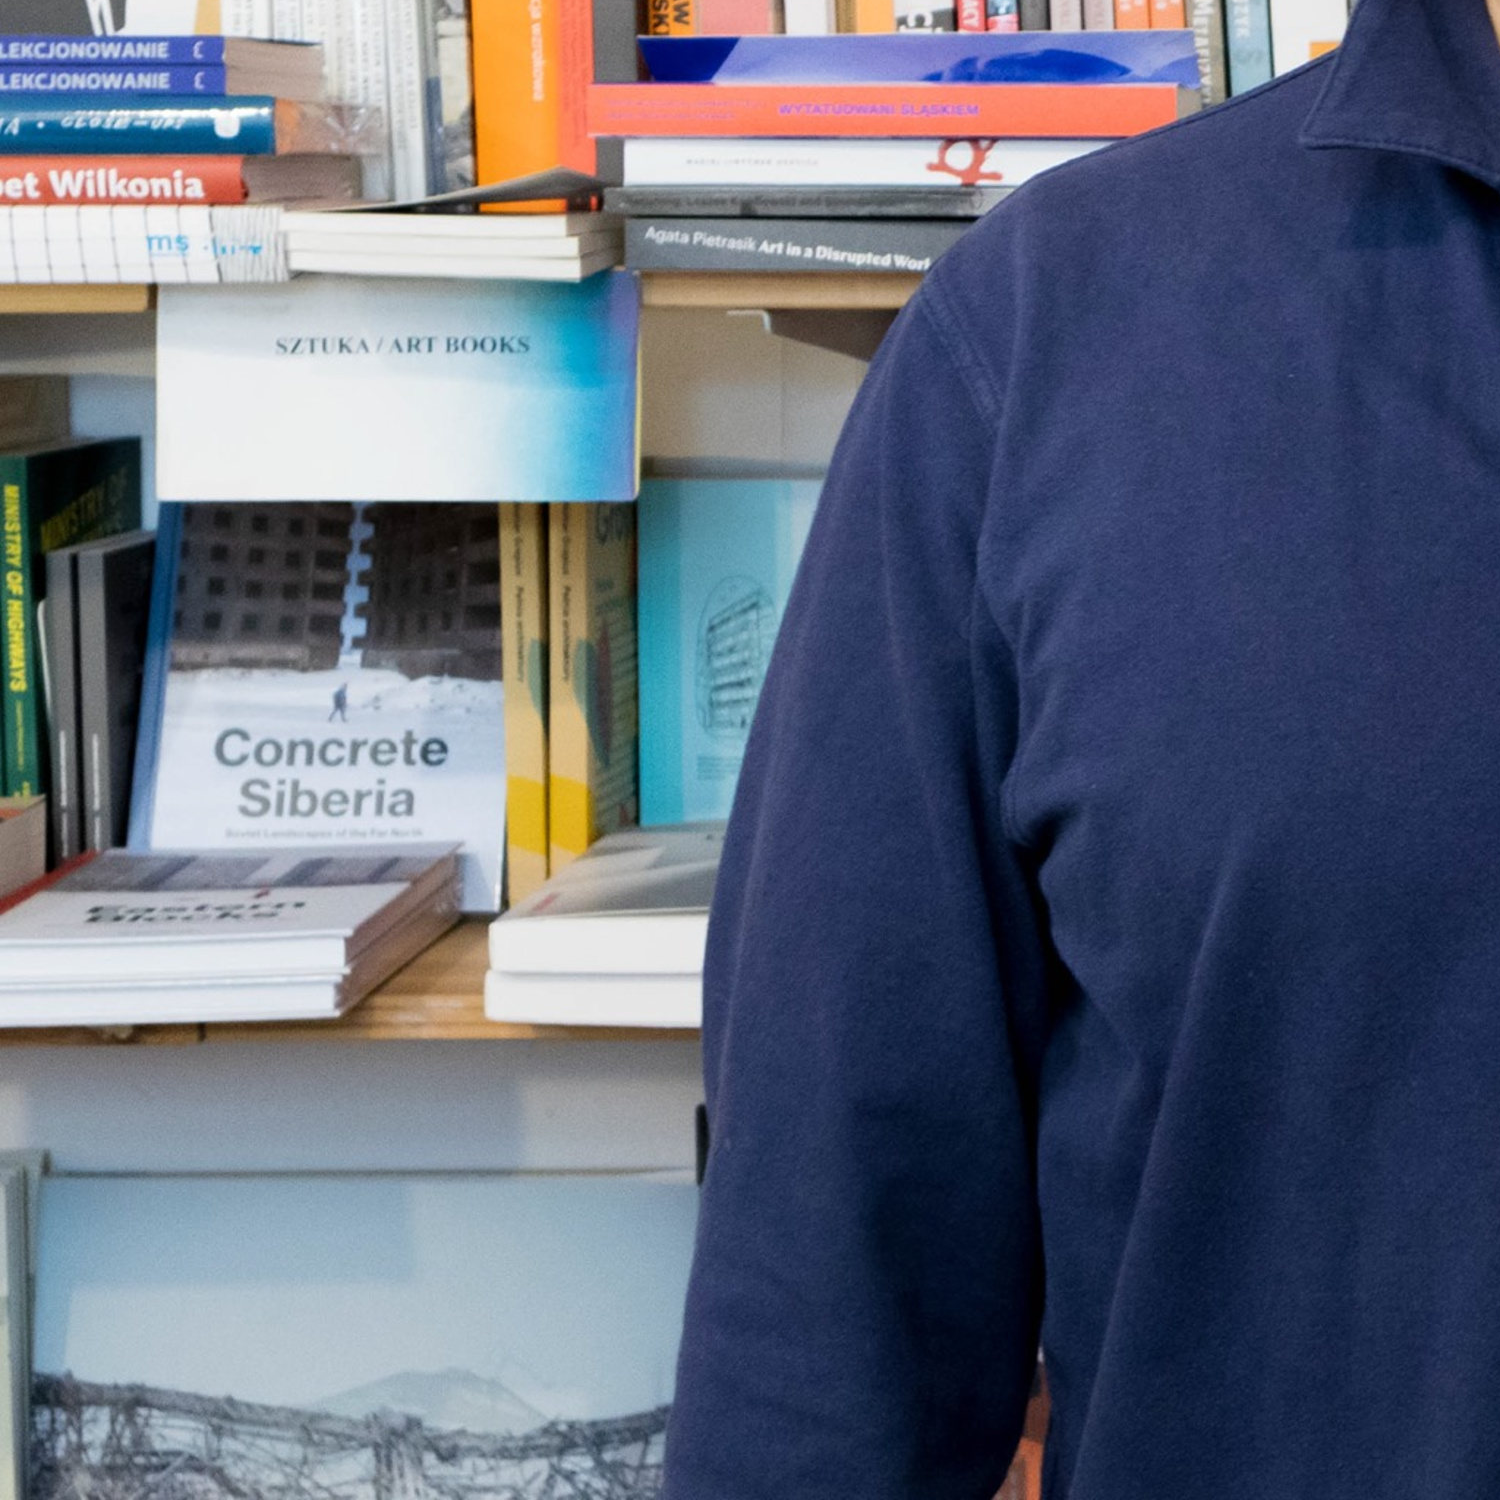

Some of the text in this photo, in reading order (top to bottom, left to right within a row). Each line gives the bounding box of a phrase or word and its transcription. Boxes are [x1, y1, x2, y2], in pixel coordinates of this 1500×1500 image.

[530, 21, 546, 101] wzrokowa
[778, 101, 897, 118] WYTATUOWANI
[900, 101, 980, 120] ŚLĄSKIEM
[49, 169, 206, 200] Wilkonia
[646, 225, 933, 270] Agata Pietrasik Art in a Disrupted Worl
[276, 335, 531, 356] SZTUKA ART BOOKS
[4, 484, 27, 692] MINISTRY OF HIGHWAYS
[214, 727, 449, 768] Concrete
[237, 778, 416, 818] Siberia
[85, 901, 306, 916] Eastern
